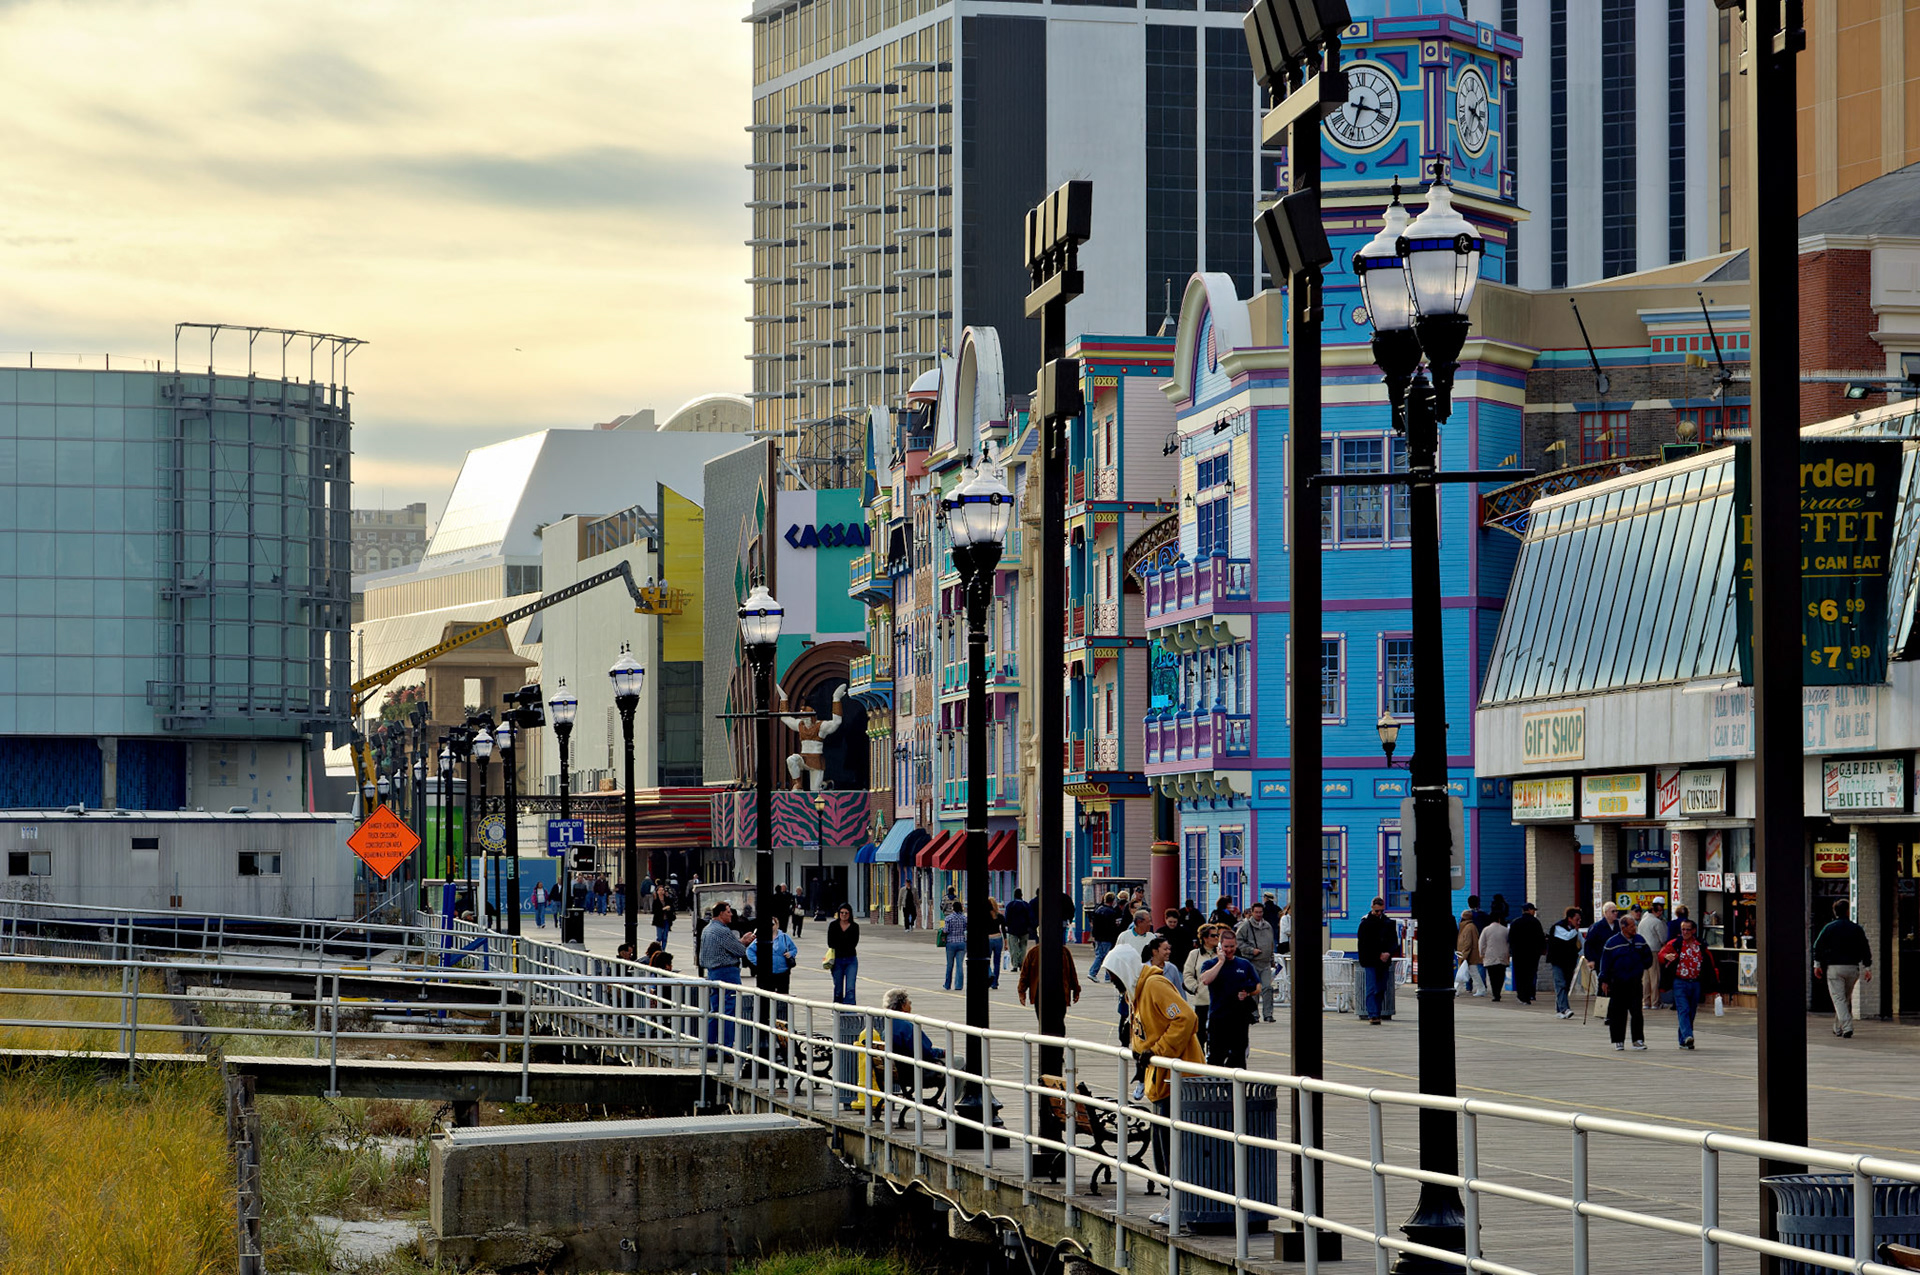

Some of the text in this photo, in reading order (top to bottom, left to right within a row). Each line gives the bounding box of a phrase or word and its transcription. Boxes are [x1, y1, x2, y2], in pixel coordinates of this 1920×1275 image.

[1815, 556, 1848, 570] CAN
[1853, 555, 1881, 569] EAT
[1808, 598, 1865, 624] $6.99
[1810, 645, 1871, 670] $7.99
[1715, 695, 1728, 718] ALL
[1731, 693, 1746, 717] YOU
[1835, 687, 1870, 708] ALL YOU
[1834, 714, 1850, 739] CAN
[1854, 711, 1870, 737] EAT
[1524, 714, 1582, 757] GIFT SHOP
[1714, 723, 1746, 747] CAN EAT
[1838, 761, 1883, 776] GARDEN
[1693, 774, 1712, 786] FROZEN
[1687, 789, 1719, 810] CUSTARD
[1838, 791, 1884, 807] BUFFET
[560, 827, 573, 841] H
[1634, 851, 1665, 859] CAMEL
[1816, 853, 1833, 861] HOT
[1699, 873, 1722, 889] PIZZA
[1166, 1003, 1181, 1019] 67
